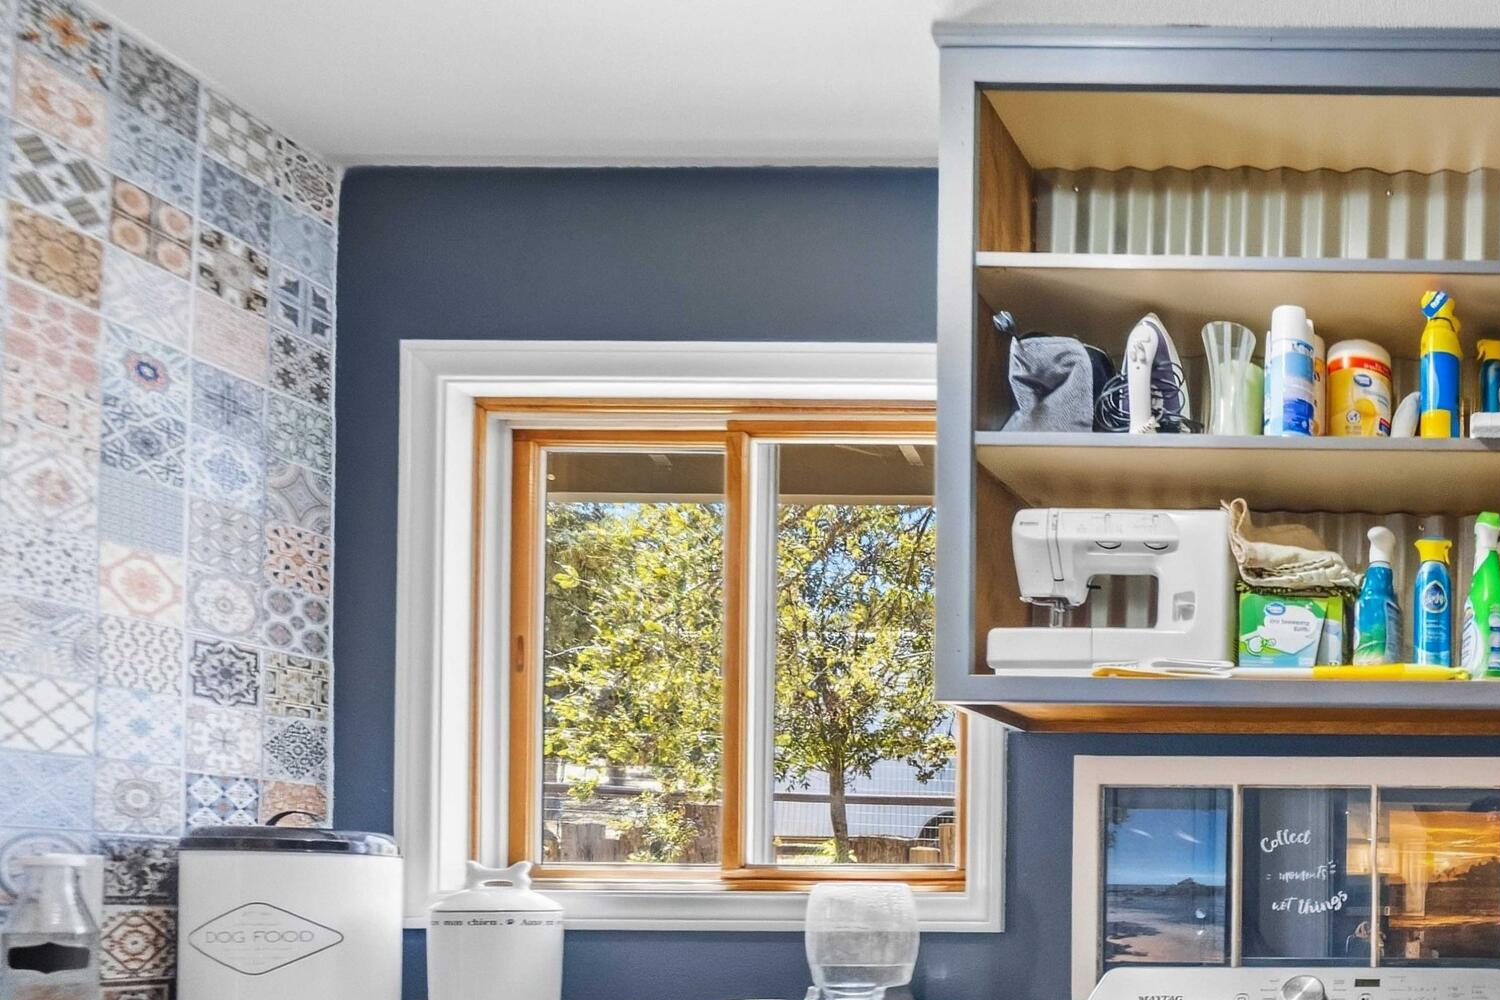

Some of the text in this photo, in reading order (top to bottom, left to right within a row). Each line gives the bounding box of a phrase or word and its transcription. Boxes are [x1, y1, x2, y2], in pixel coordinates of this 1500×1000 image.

[1260, 829, 1312, 853] Collect
[1279, 865, 1328, 882] moments
[1272, 890, 1348, 915] not things
[206, 930, 314, 943] DOG FOOD
